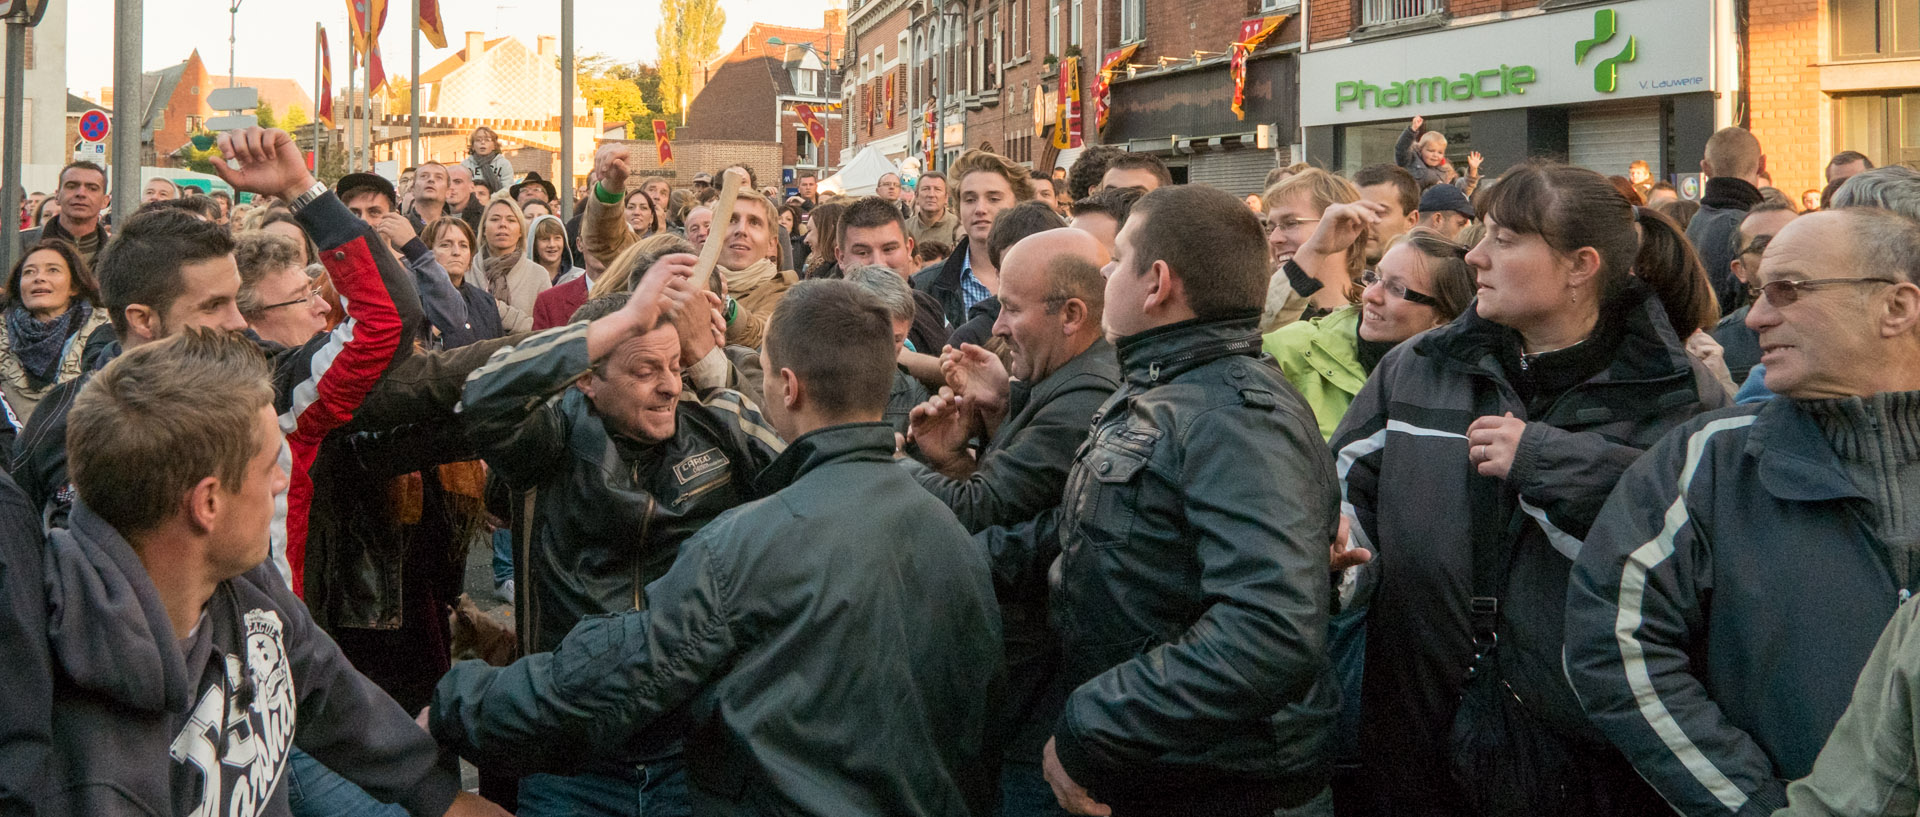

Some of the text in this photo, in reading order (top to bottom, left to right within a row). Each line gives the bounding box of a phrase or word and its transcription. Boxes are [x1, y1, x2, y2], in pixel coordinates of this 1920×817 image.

[1336, 64, 1536, 112] Pharmacie
[1639, 80, 1649, 89] V.
[247, 622, 277, 638] EAGUE
